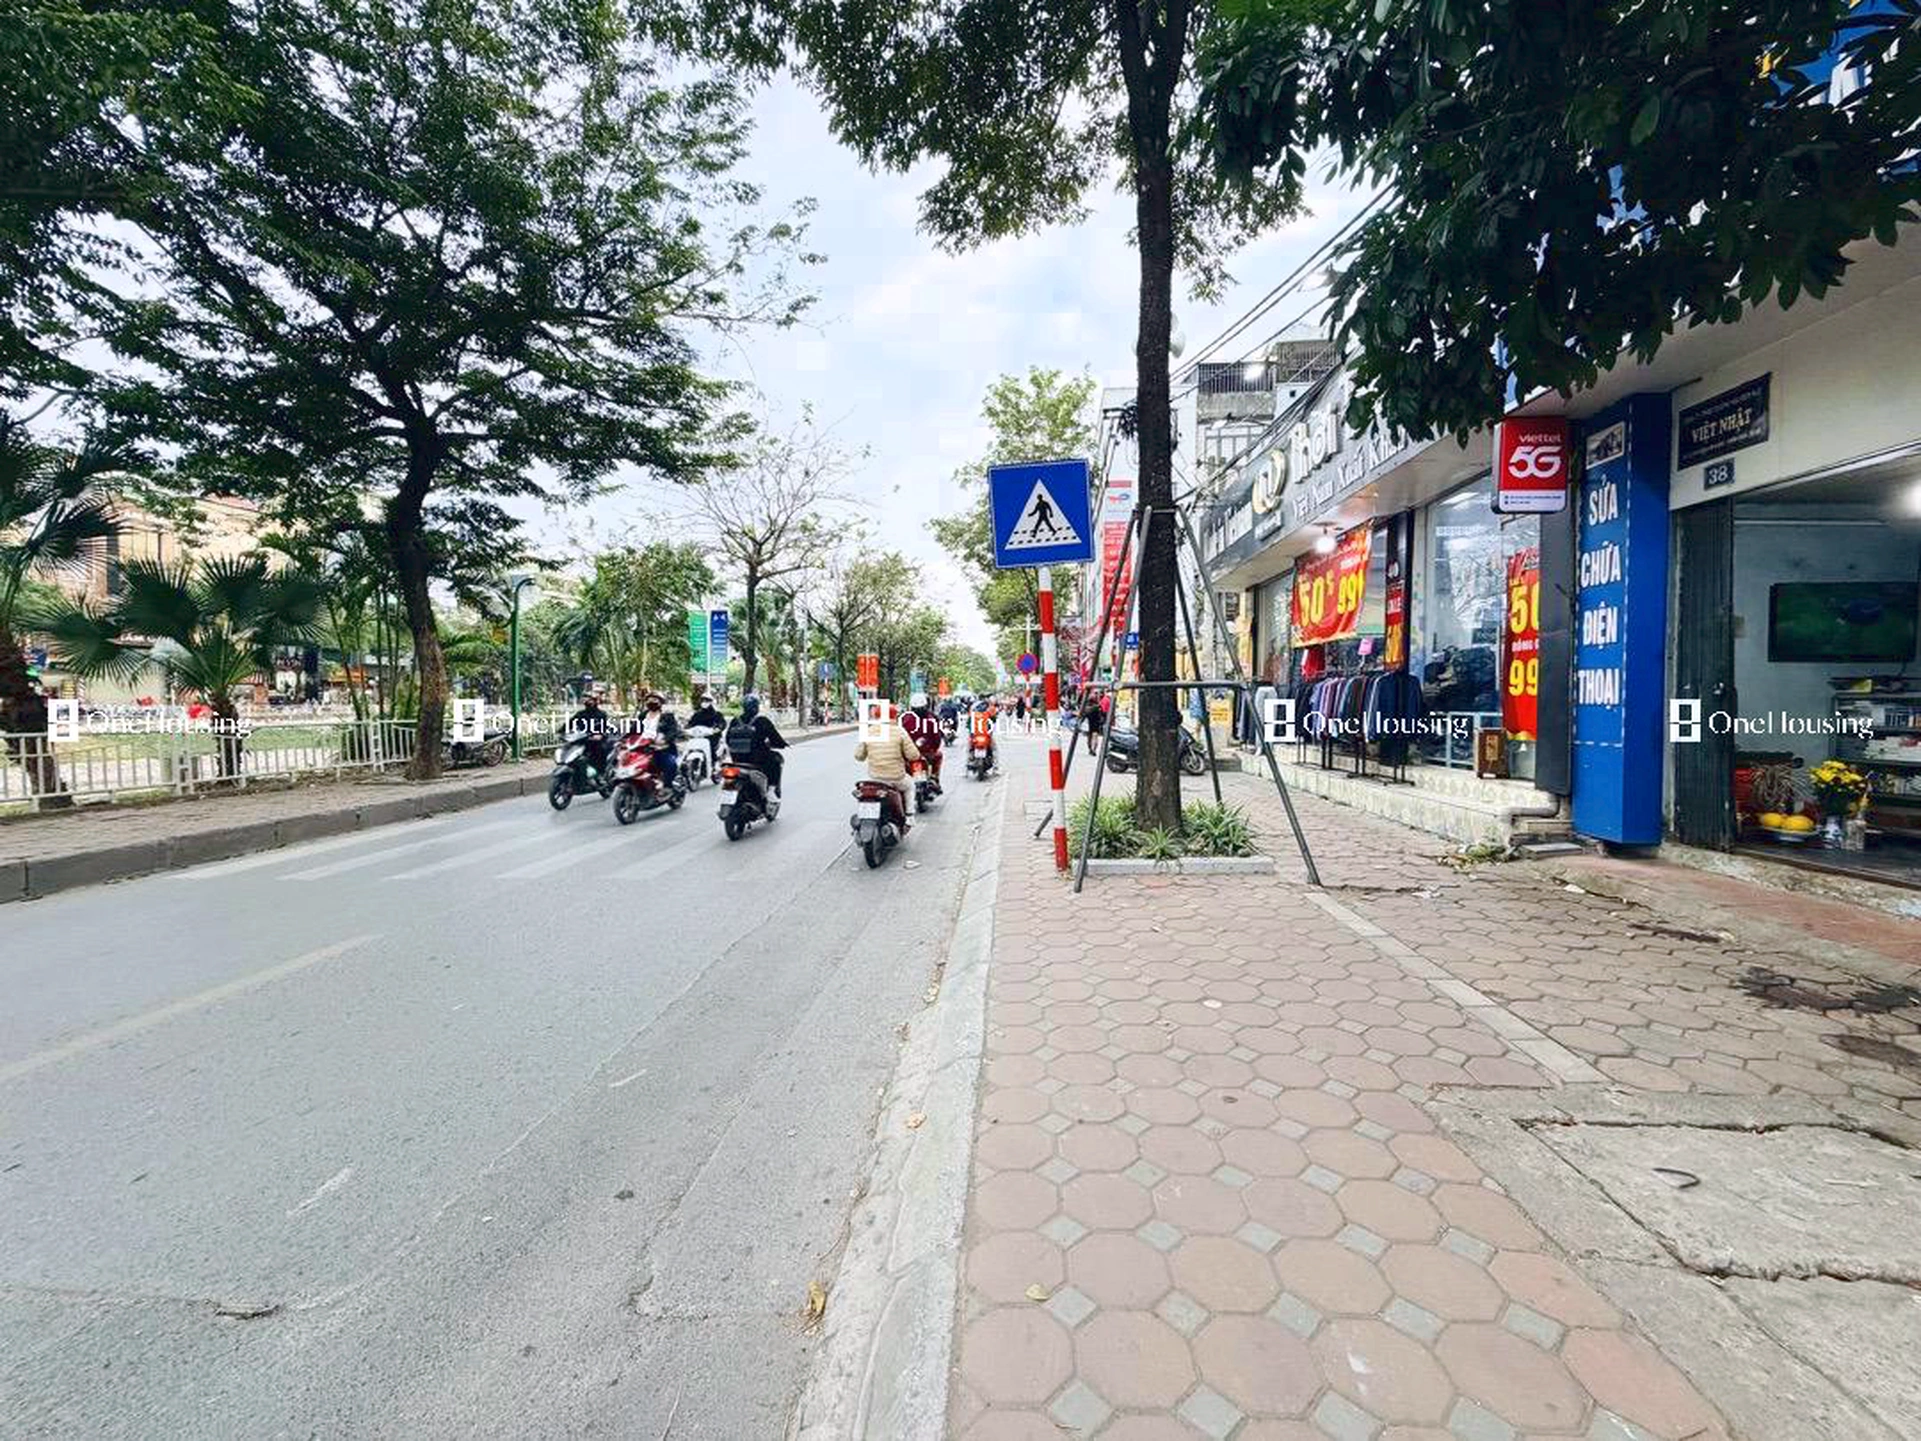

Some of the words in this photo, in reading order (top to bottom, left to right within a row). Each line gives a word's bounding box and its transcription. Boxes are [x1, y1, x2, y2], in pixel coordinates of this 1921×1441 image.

[1520, 433, 1562, 442] viettel
[1508, 446, 1562, 478] 5G
[1708, 465, 1728, 485] 38
[1588, 474, 1618, 525] SỬA
[1580, 541, 1622, 588] CHỮA
[1583, 602, 1618, 649] ĐIỆN
[1577, 669, 1619, 710] THOẠI
